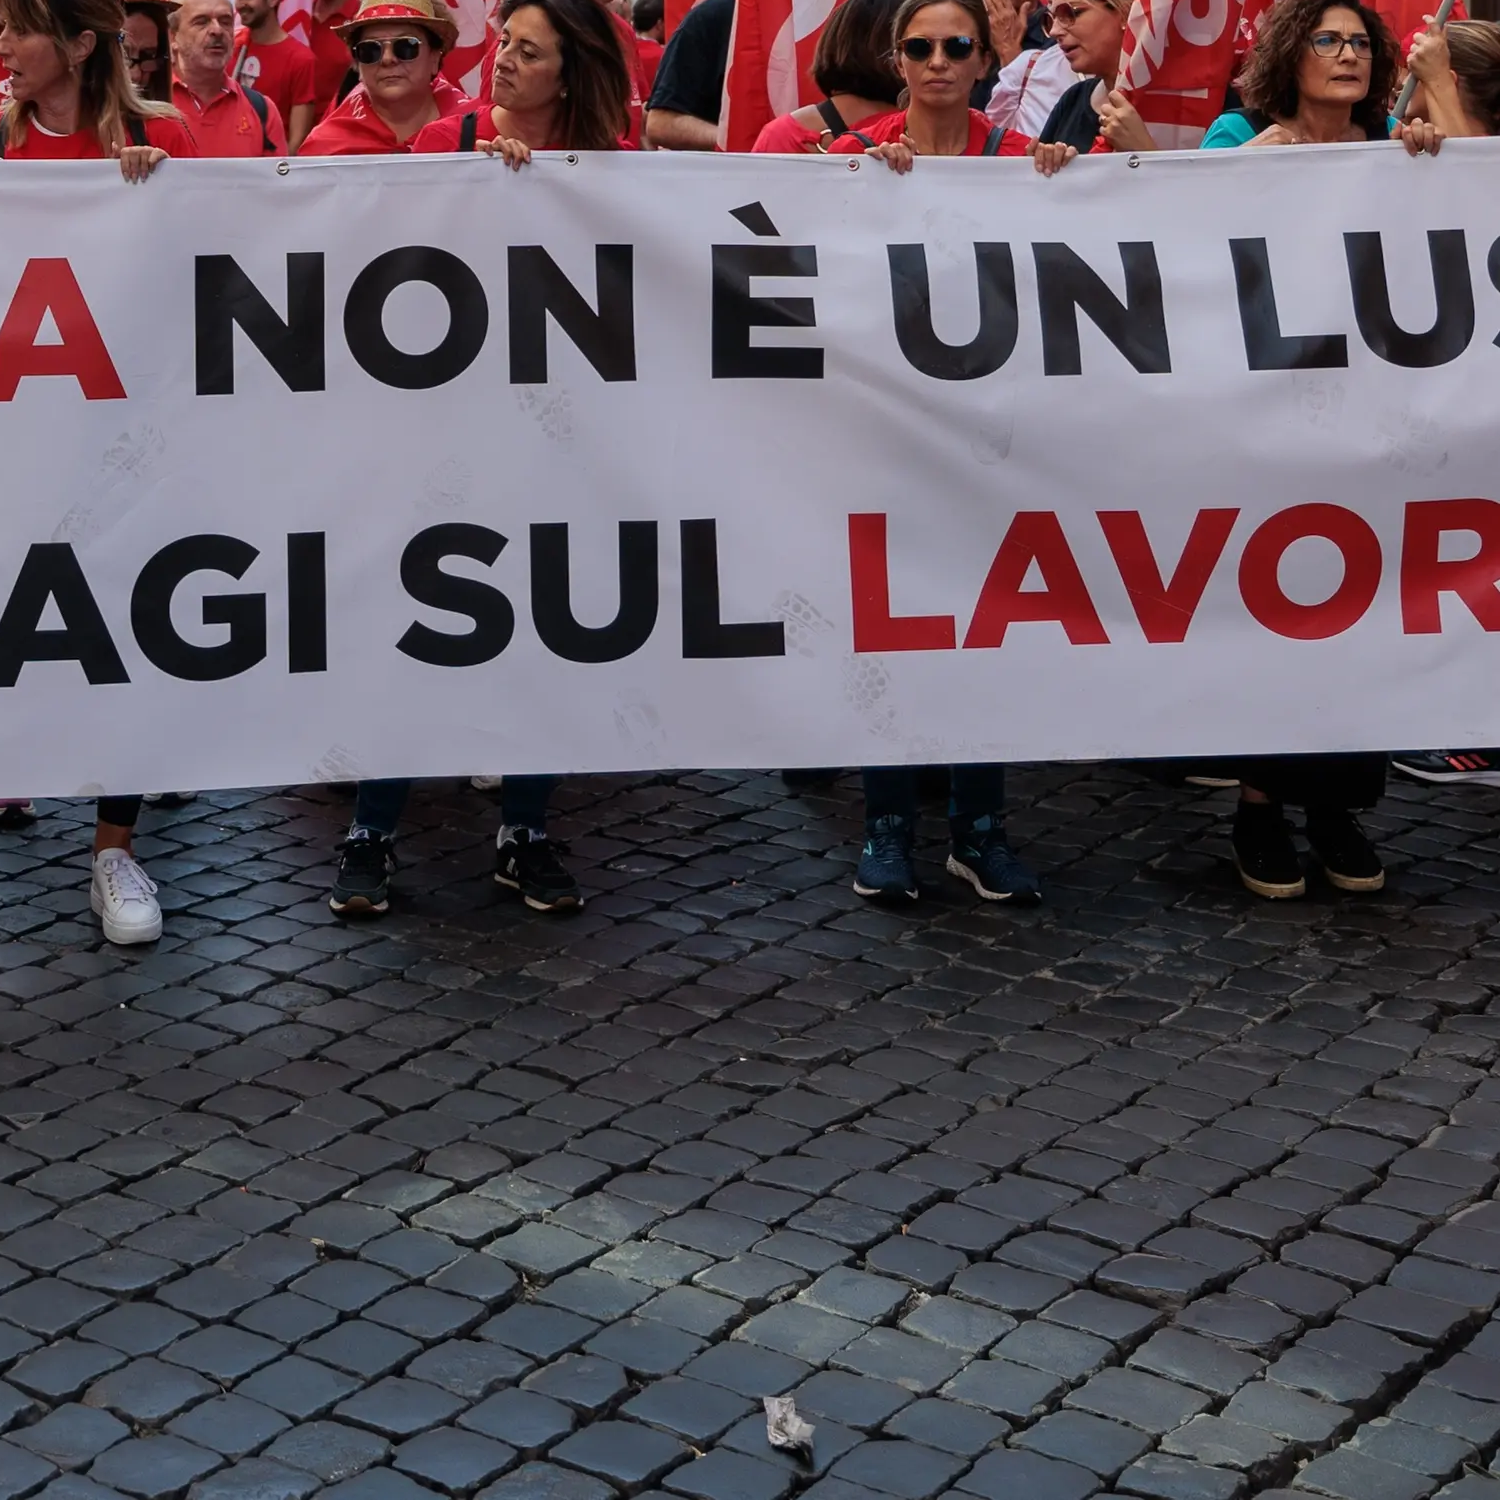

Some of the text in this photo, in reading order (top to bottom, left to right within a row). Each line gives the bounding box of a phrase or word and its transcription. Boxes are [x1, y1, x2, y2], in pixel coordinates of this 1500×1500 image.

[194, 243, 637, 396] NON
[711, 201, 825, 380] È
[887, 241, 1172, 381] UN
[1229, 229, 1500, 371] LU
[395, 518, 786, 668] SUL
[848, 498, 1500, 653] LAVOR
